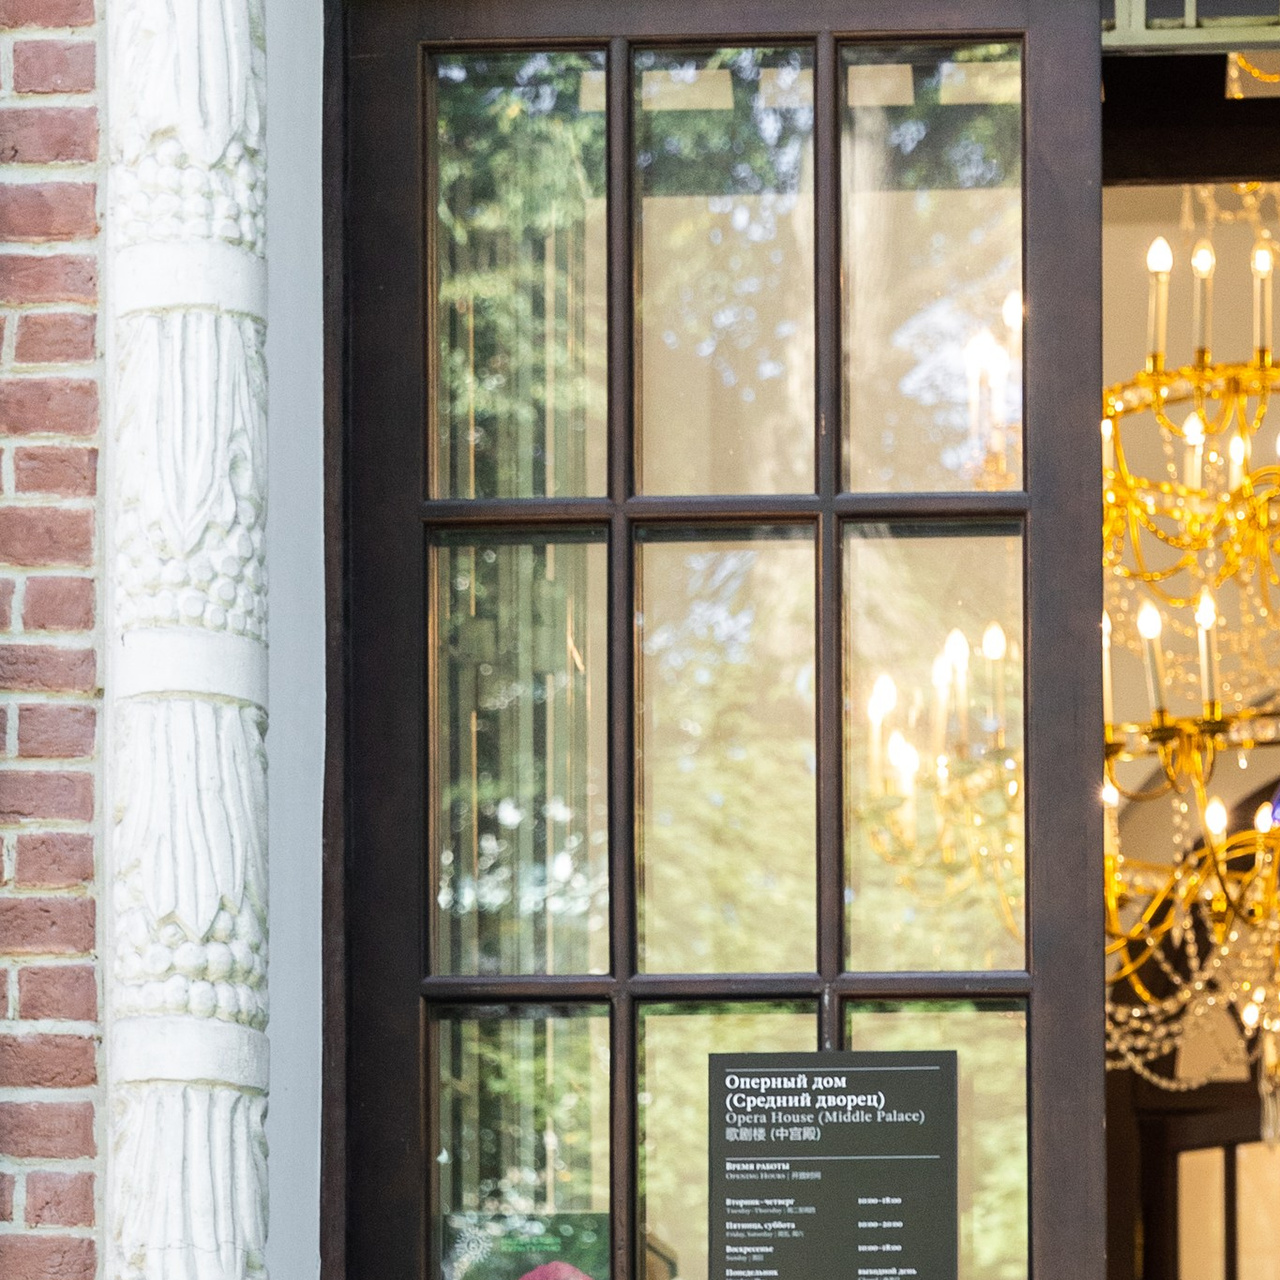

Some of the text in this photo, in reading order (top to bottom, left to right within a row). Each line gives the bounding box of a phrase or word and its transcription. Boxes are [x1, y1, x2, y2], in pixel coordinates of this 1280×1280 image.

[725, 1074, 847, 1093] Оперный дом
[725, 1091, 886, 1111] (Средний дворец)
[725, 1110, 926, 1126] Opera House (Middle Palace)
